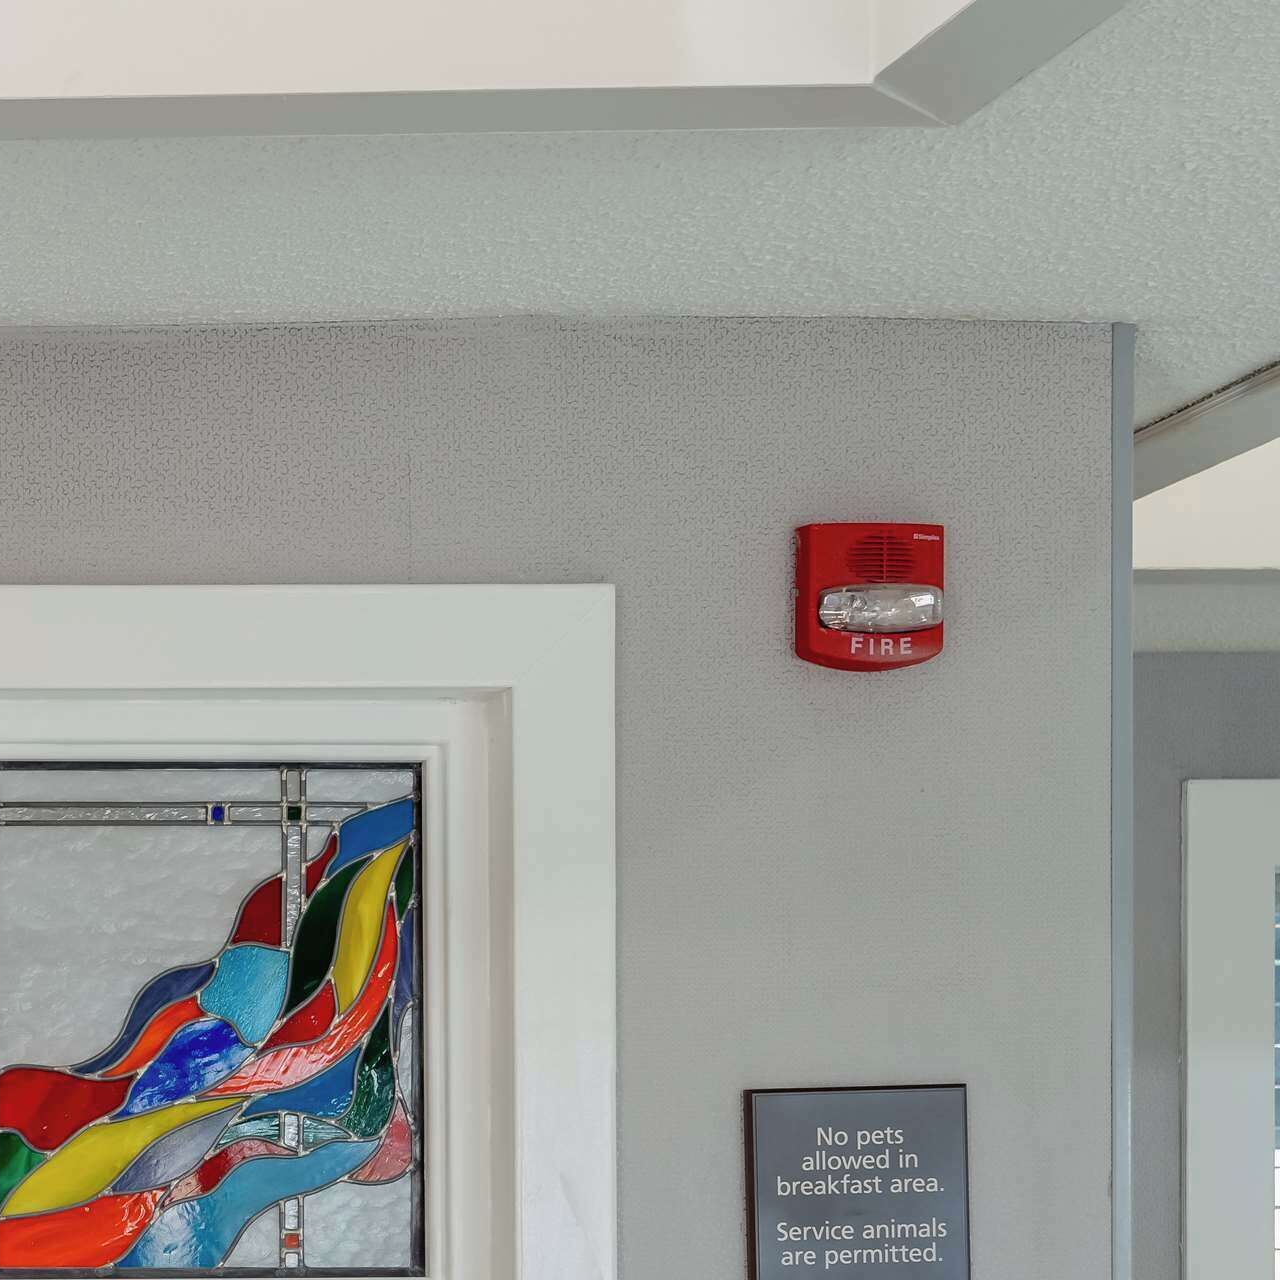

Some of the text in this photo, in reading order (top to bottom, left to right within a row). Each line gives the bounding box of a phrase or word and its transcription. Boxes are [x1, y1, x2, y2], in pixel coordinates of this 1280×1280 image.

[851, 637, 912, 656] FIRE
[816, 1126, 904, 1150] No pets
[801, 1149, 918, 1171] allowed in
[777, 1174, 945, 1196] breakfast area.
[776, 1217, 948, 1242] Service animals
[781, 1242, 943, 1270] are permitted.
